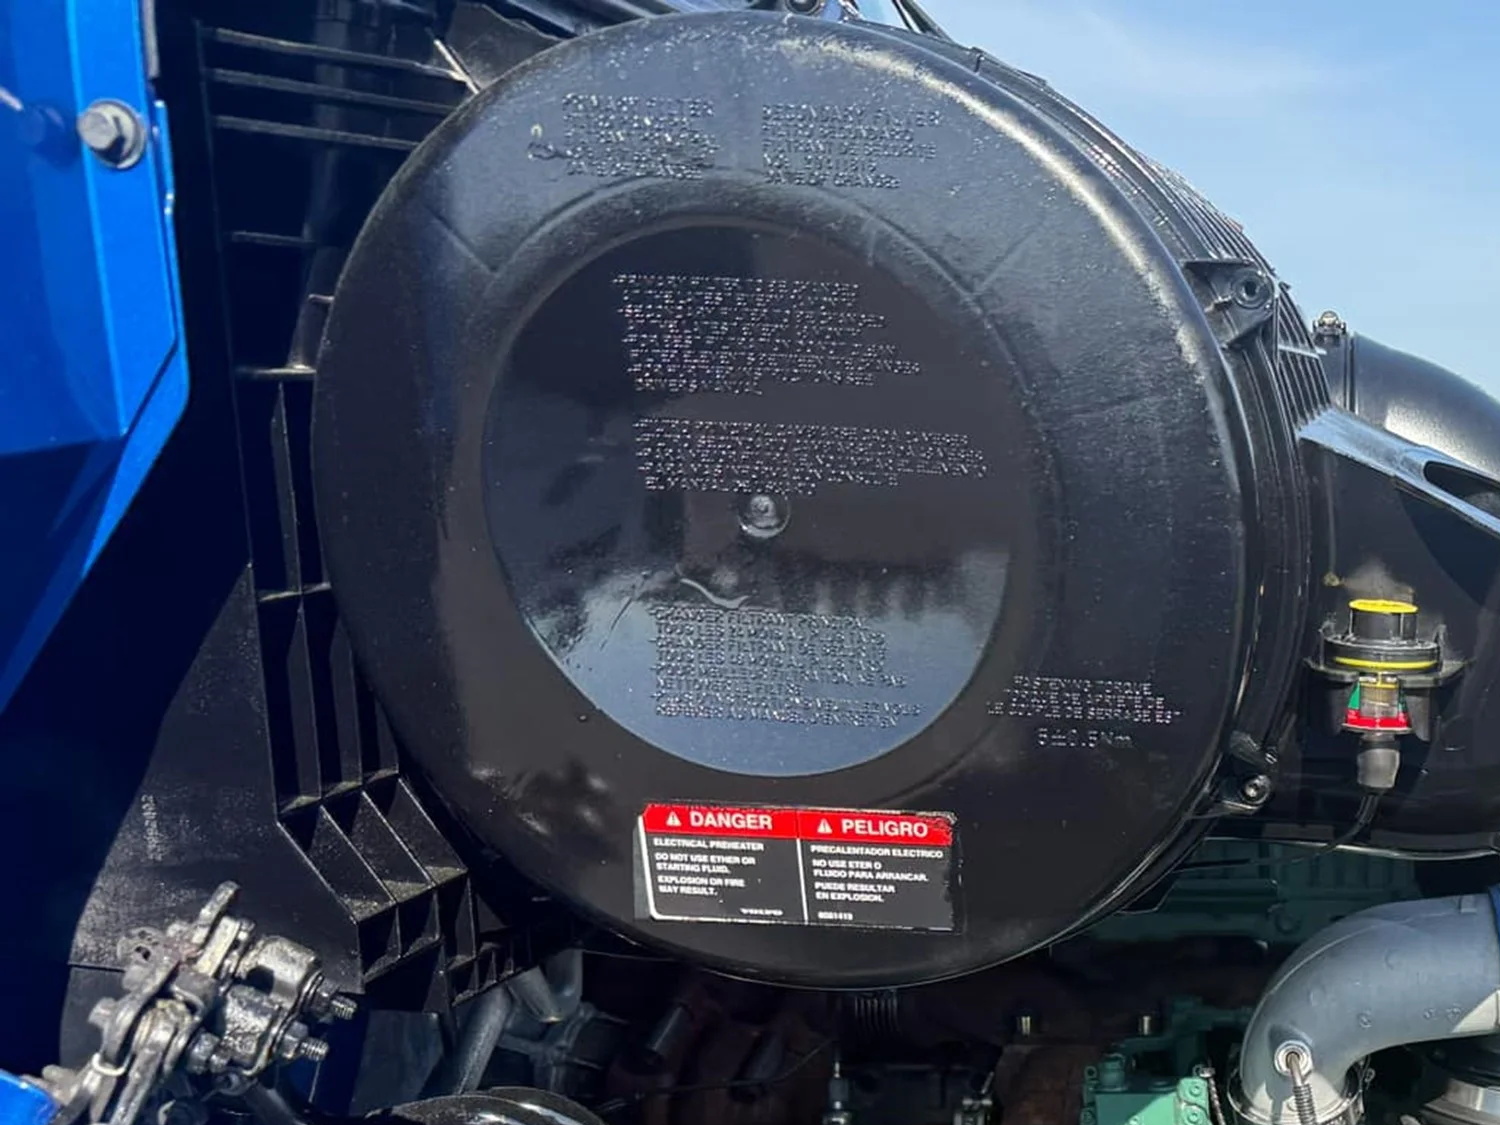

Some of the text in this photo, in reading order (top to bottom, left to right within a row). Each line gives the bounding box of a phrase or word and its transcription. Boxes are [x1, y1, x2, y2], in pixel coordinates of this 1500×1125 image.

[690, 811, 772, 830] DANGER
[841, 819, 928, 837] PELIGRO
[653, 838, 764, 851] ELECTRICAL PREHEATER
[810, 845, 944, 859] PRECALENTADOR ELECTRICO
[655, 853, 756, 865] DO NOT USE ETHER OR
[812, 859, 882, 870] NO USE ETER O
[656, 863, 701, 872] STARTING
[813, 870, 847, 878] FLUIDO
[849, 872, 874, 880] PARA
[657, 875, 745, 887] EXPLOSION OR FIRE
[659, 885, 679, 894] MAY
[815, 882, 895, 893] PUEDE RESULTAR
[816, 892, 829, 900] EN
